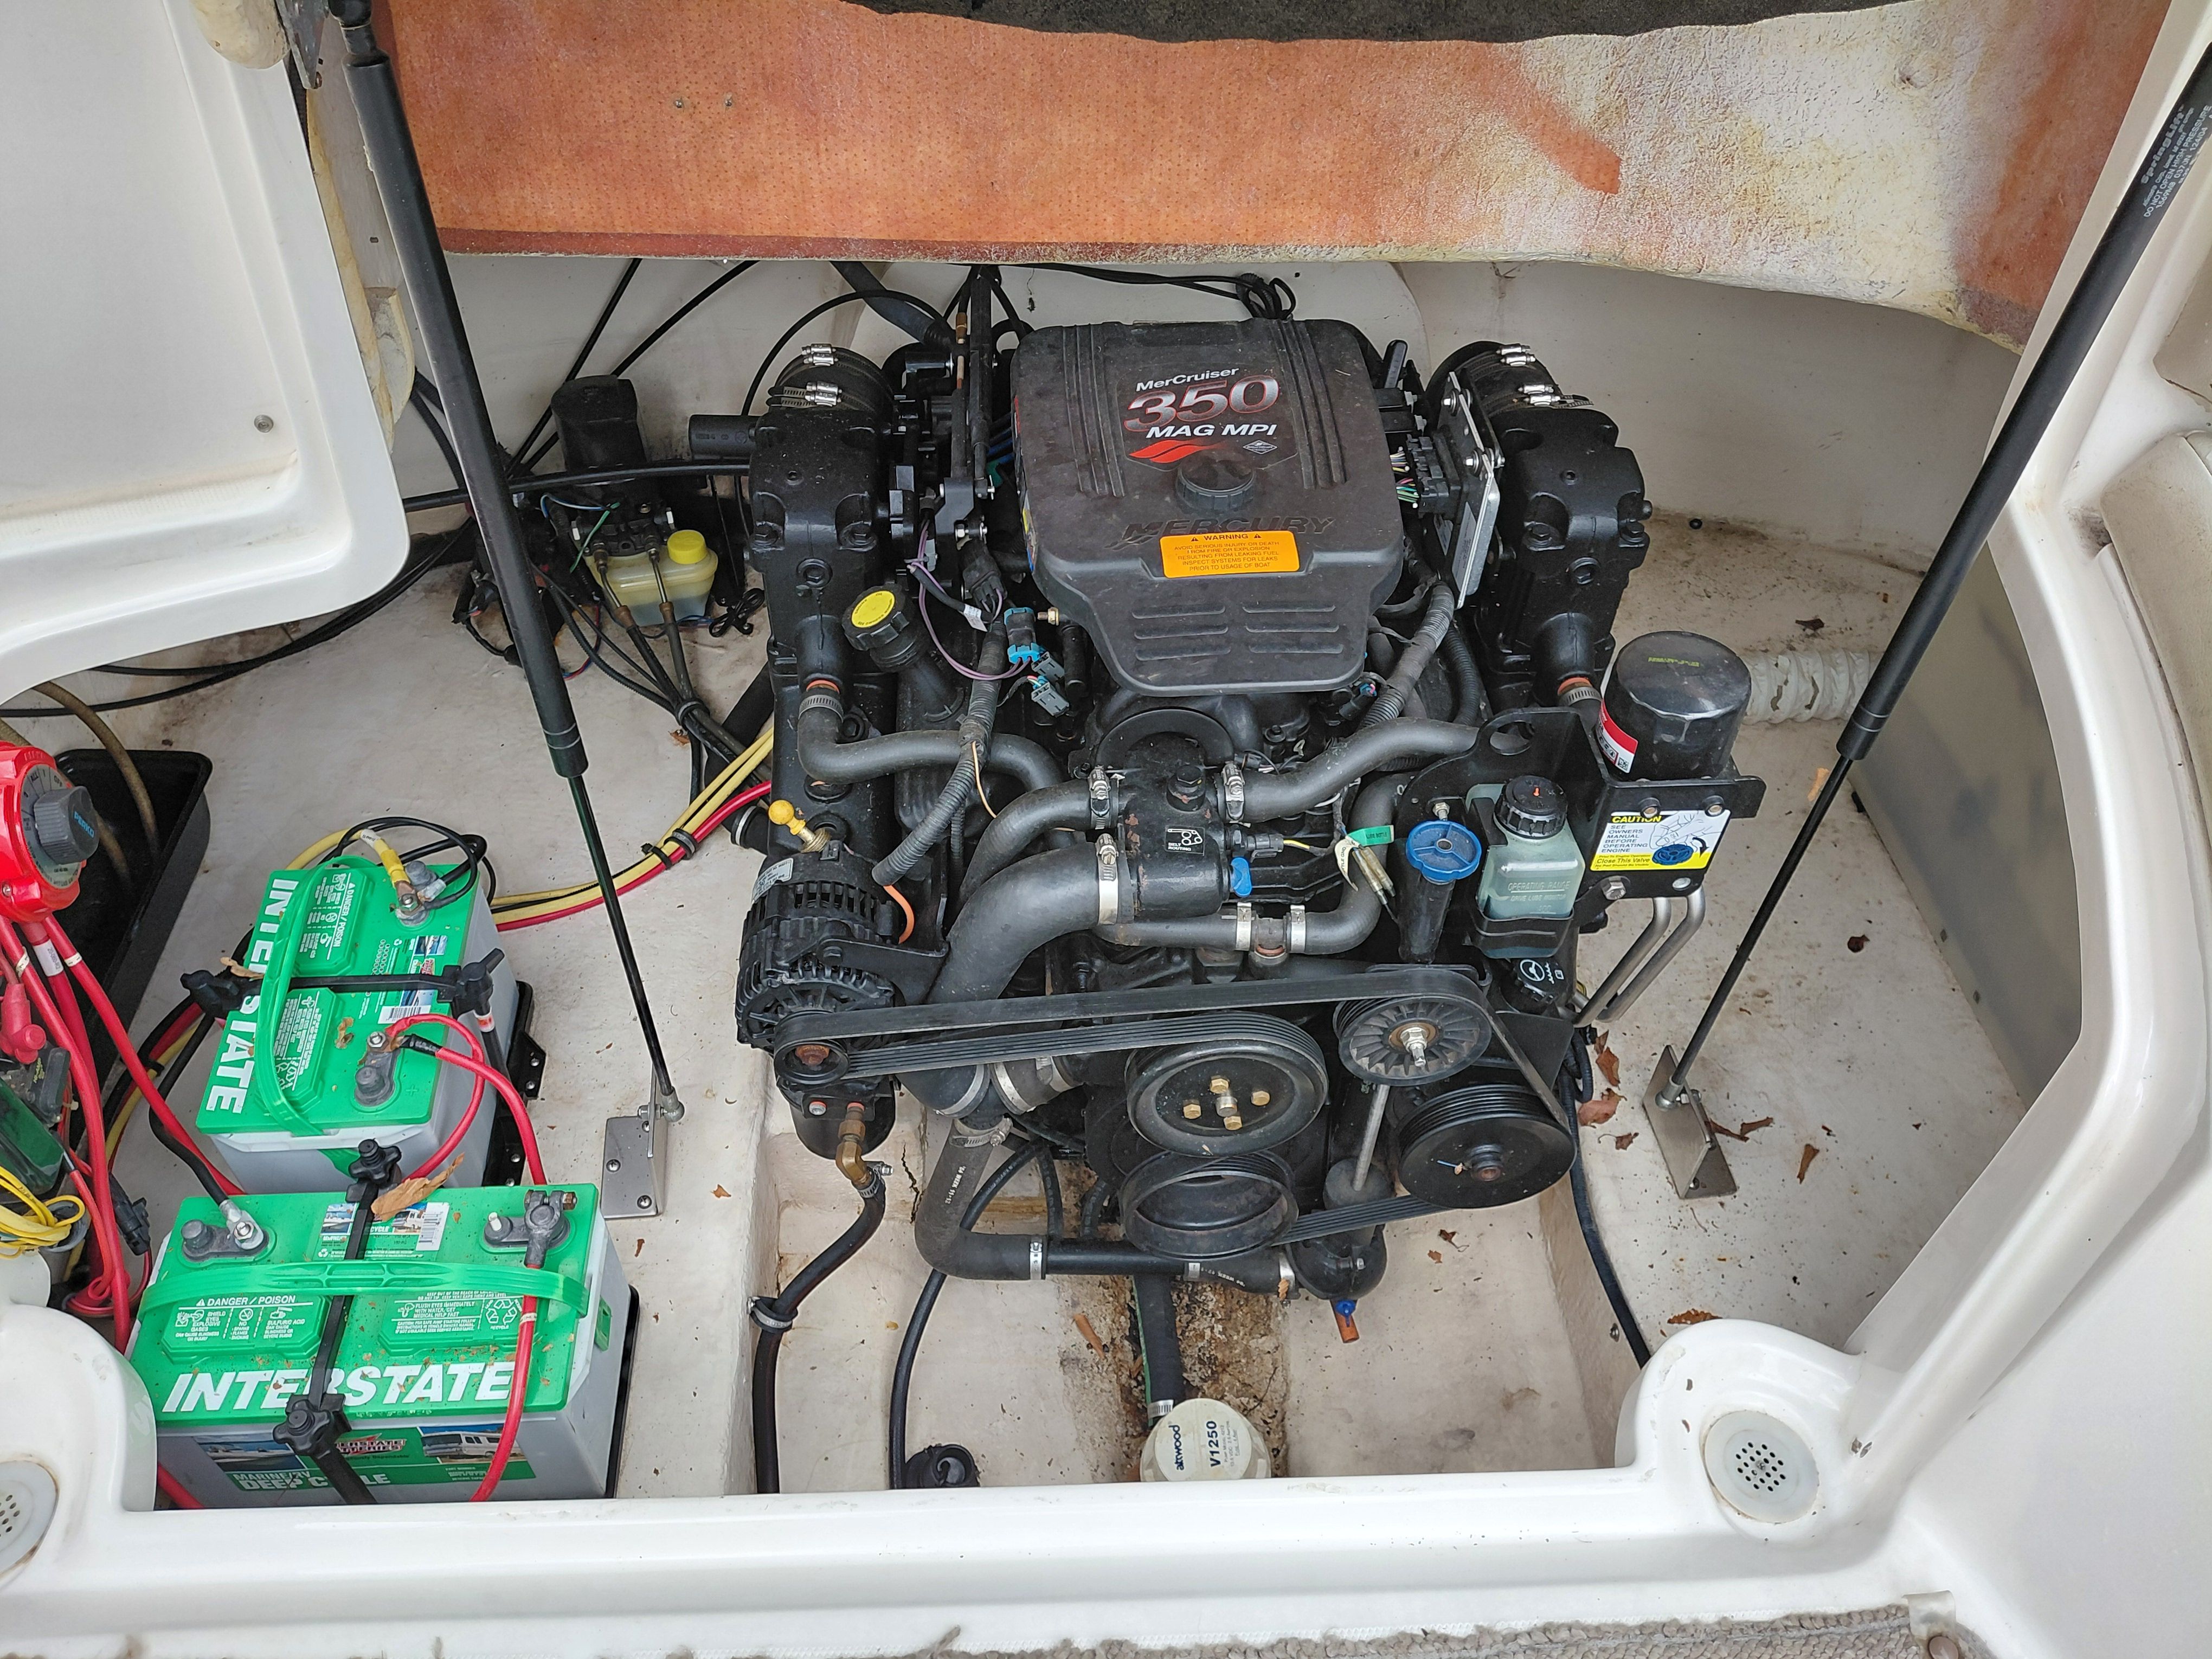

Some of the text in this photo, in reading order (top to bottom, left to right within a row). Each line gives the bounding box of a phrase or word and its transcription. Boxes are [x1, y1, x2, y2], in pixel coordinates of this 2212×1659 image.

[2144, 207, 2154, 217] DO
[2150, 189, 2163, 208] NOT
[2159, 166, 2176, 190] OPEN
[2171, 144, 2187, 168] HIGH
[2182, 105, 2212, 148] PRESSURE
[1136, 368, 1239, 391] MerCruiser
[1124, 375, 1279, 432] 350
[1146, 425, 1277, 438] MAG MPI
[1118, 517, 1334, 543] MERCURY
[74, 811, 94, 838] PERKO
[1508, 881, 1571, 891] OPERATING RANGE
[342, 890, 354, 916] DANGER
[333, 922, 346, 947] POISON
[951, 1174, 962, 1188] WEEK
[207, 1297, 248, 1306] DANGER
[258, 1296, 295, 1304] POISON
[1206, 1420, 1221, 1467] V1250
[233, 1471, 311, 1481] MARINE/RV
[239, 1474, 390, 1490] DEEP CLE
